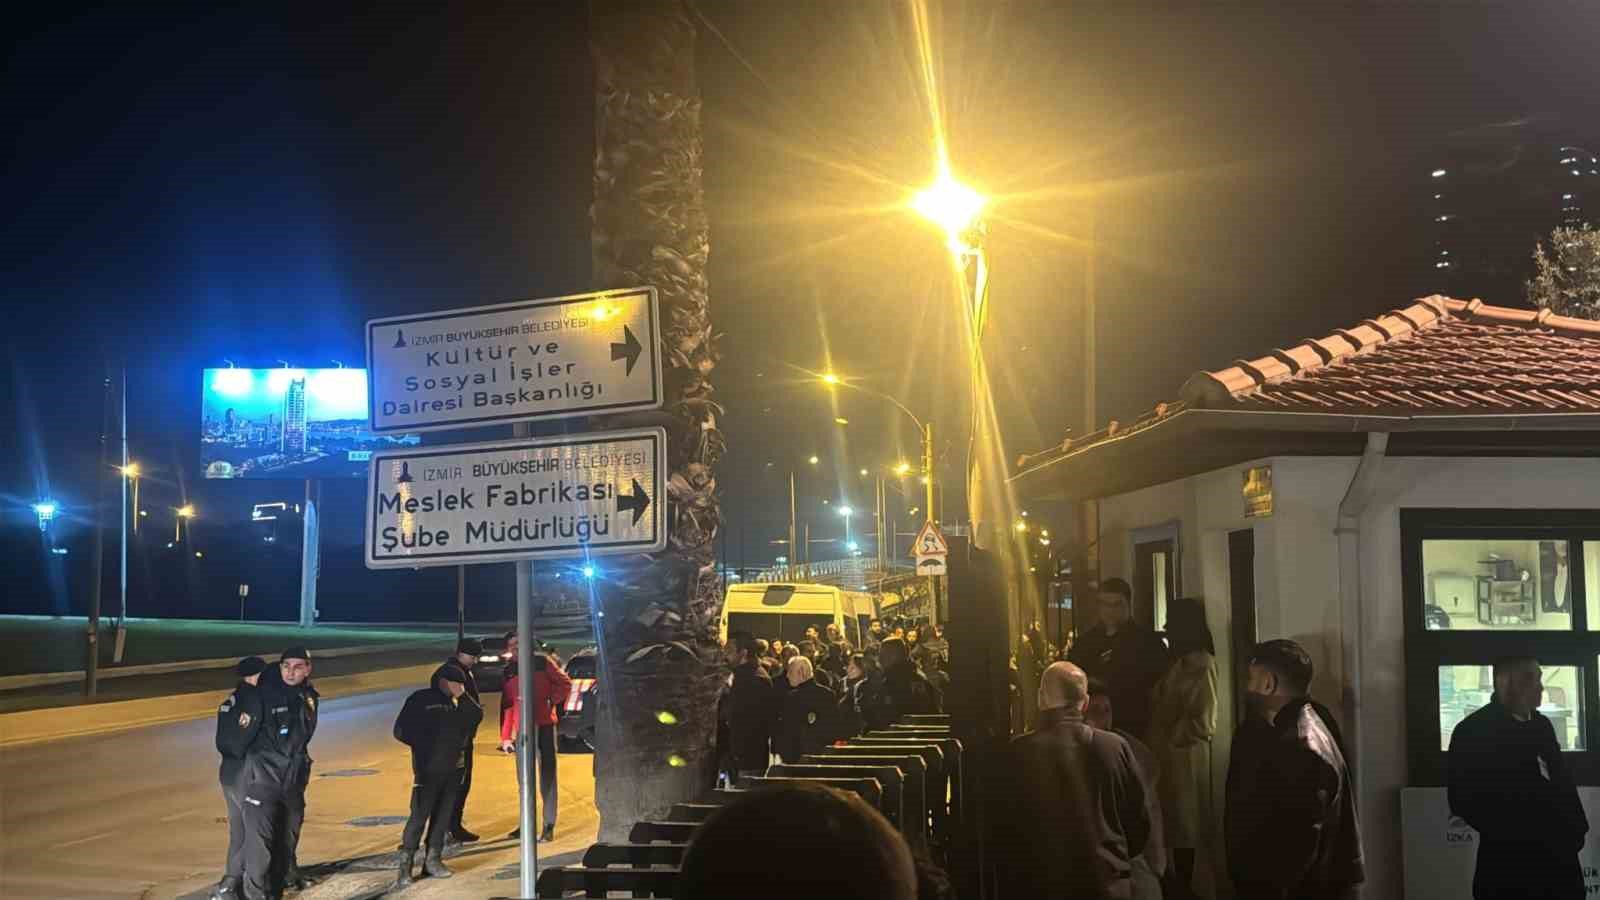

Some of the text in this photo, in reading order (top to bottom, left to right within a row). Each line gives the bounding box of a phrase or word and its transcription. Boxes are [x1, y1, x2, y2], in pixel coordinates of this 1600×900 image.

[426, 341, 559, 367] Kültür ve
[405, 361, 576, 391] Sosyal İşler
[383, 382, 602, 416] Dairesi Başkanlığı
[379, 478, 613, 515] Meslek Fabrikası
[382, 514, 609, 553] Şube Müdürlüğü
